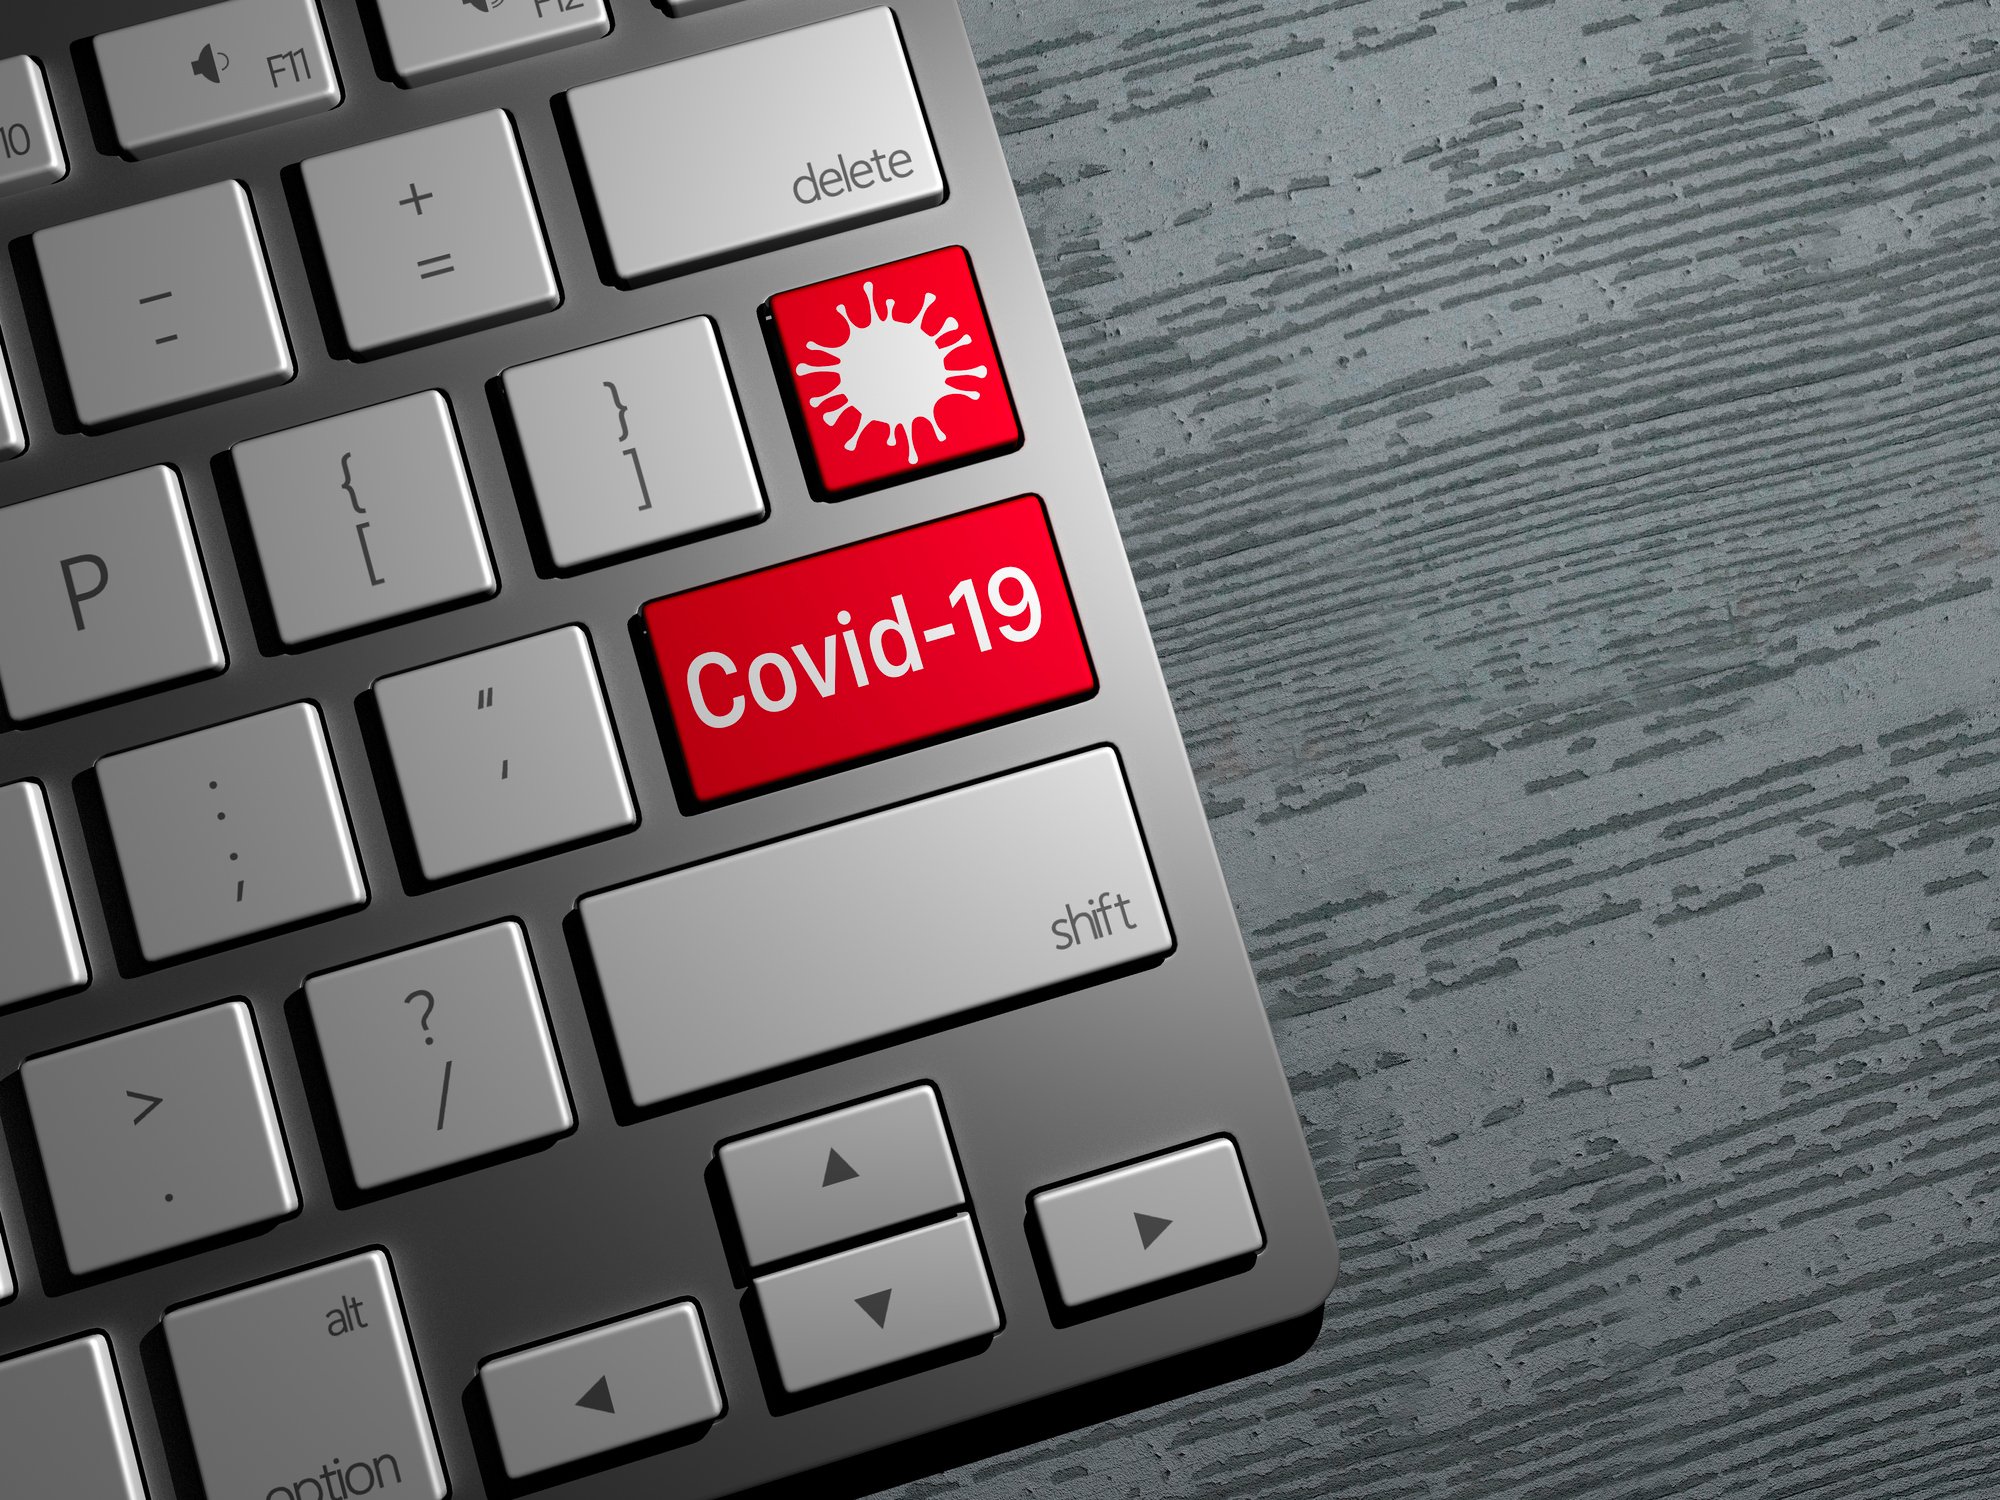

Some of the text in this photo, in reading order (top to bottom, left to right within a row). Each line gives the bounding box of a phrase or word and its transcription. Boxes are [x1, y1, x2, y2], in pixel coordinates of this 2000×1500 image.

[266, 47, 312, 89] F11
[398, 182, 434, 216] +
[792, 147, 914, 204] delete
[416, 253, 455, 280] =
[602, 381, 629, 443] }
[340, 451, 367, 514] {
[622, 447, 653, 512] ]
[355, 521, 386, 587] [
[59, 553, 109, 632] P
[685, 566, 1042, 729] Covid-19
[1050, 891, 1138, 951] shift
[403, 989, 435, 1046] ?
[125, 1090, 164, 1126] >
[436, 1060, 453, 1131] /
[325, 1295, 369, 1337] alt
